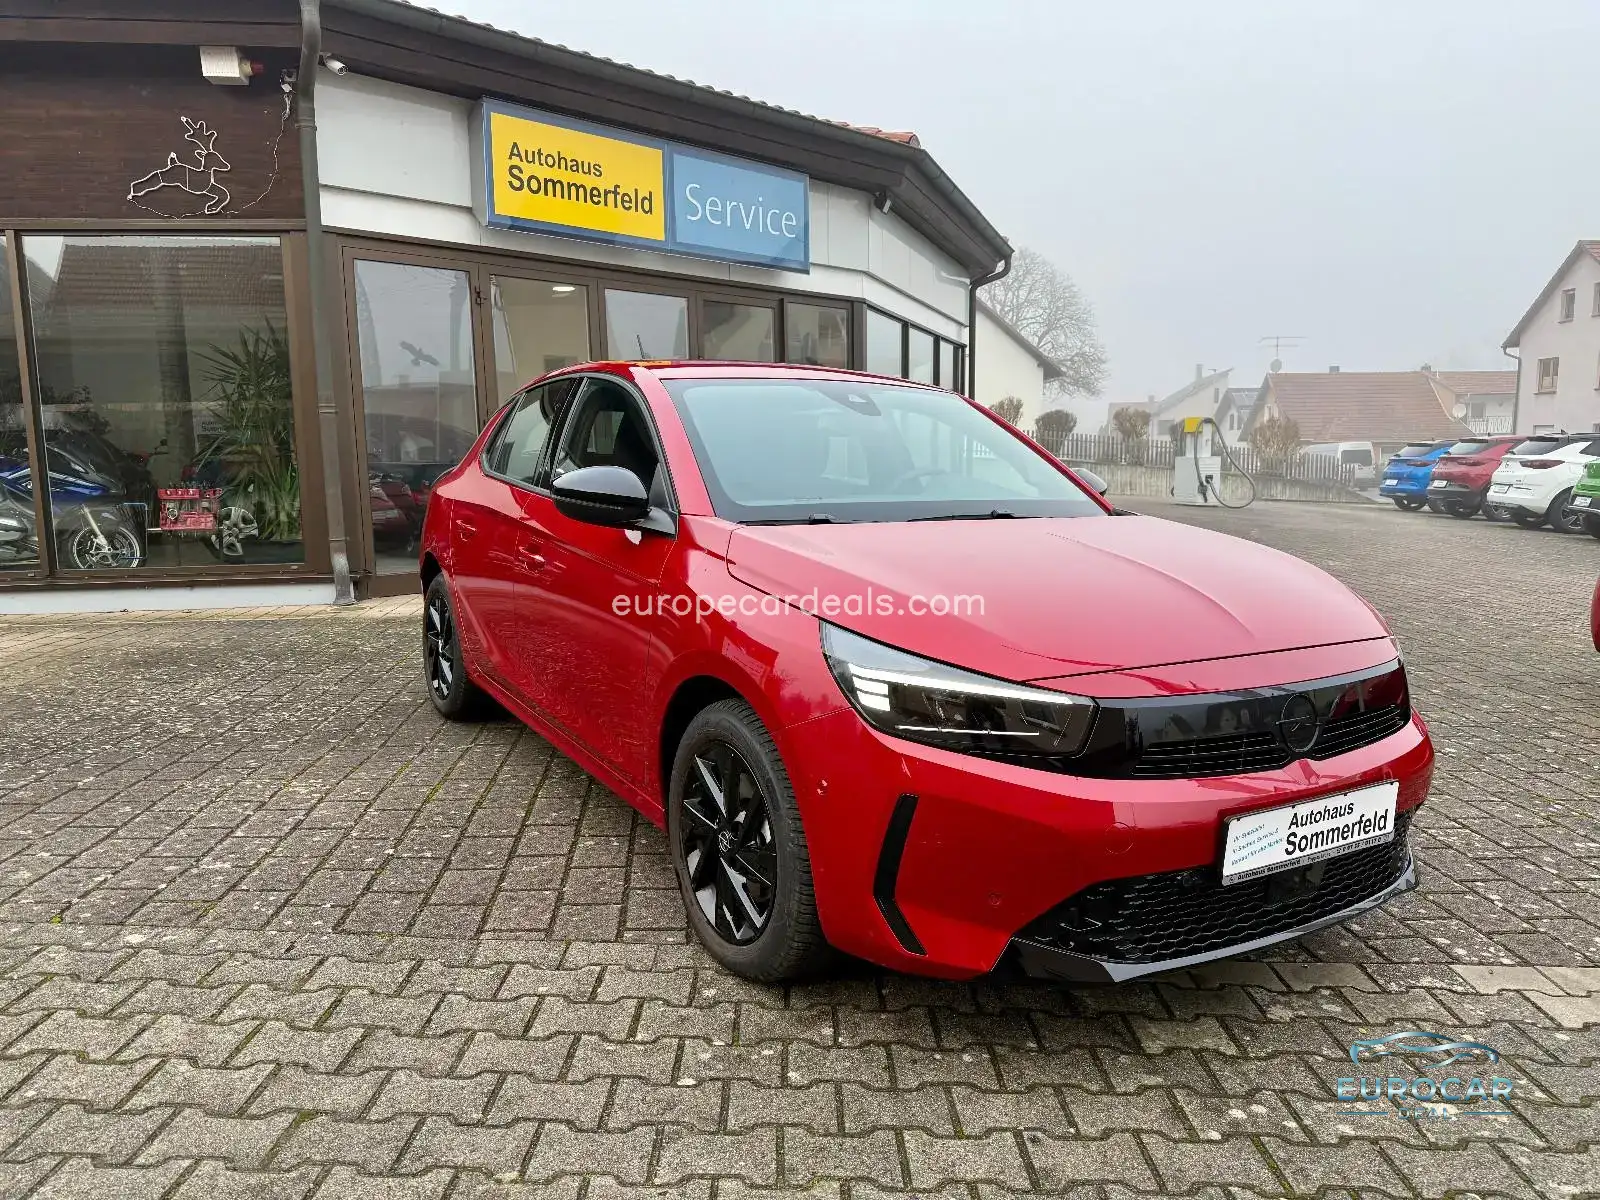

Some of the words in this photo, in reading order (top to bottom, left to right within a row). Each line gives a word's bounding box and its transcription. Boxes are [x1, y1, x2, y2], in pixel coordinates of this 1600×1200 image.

[508, 141, 603, 178] Autohaus
[508, 165, 653, 215] Sommerfeld
[685, 183, 797, 238] Service
[1285, 809, 1388, 856] Sommerfeld
[1288, 802, 1354, 830] Autohaus
